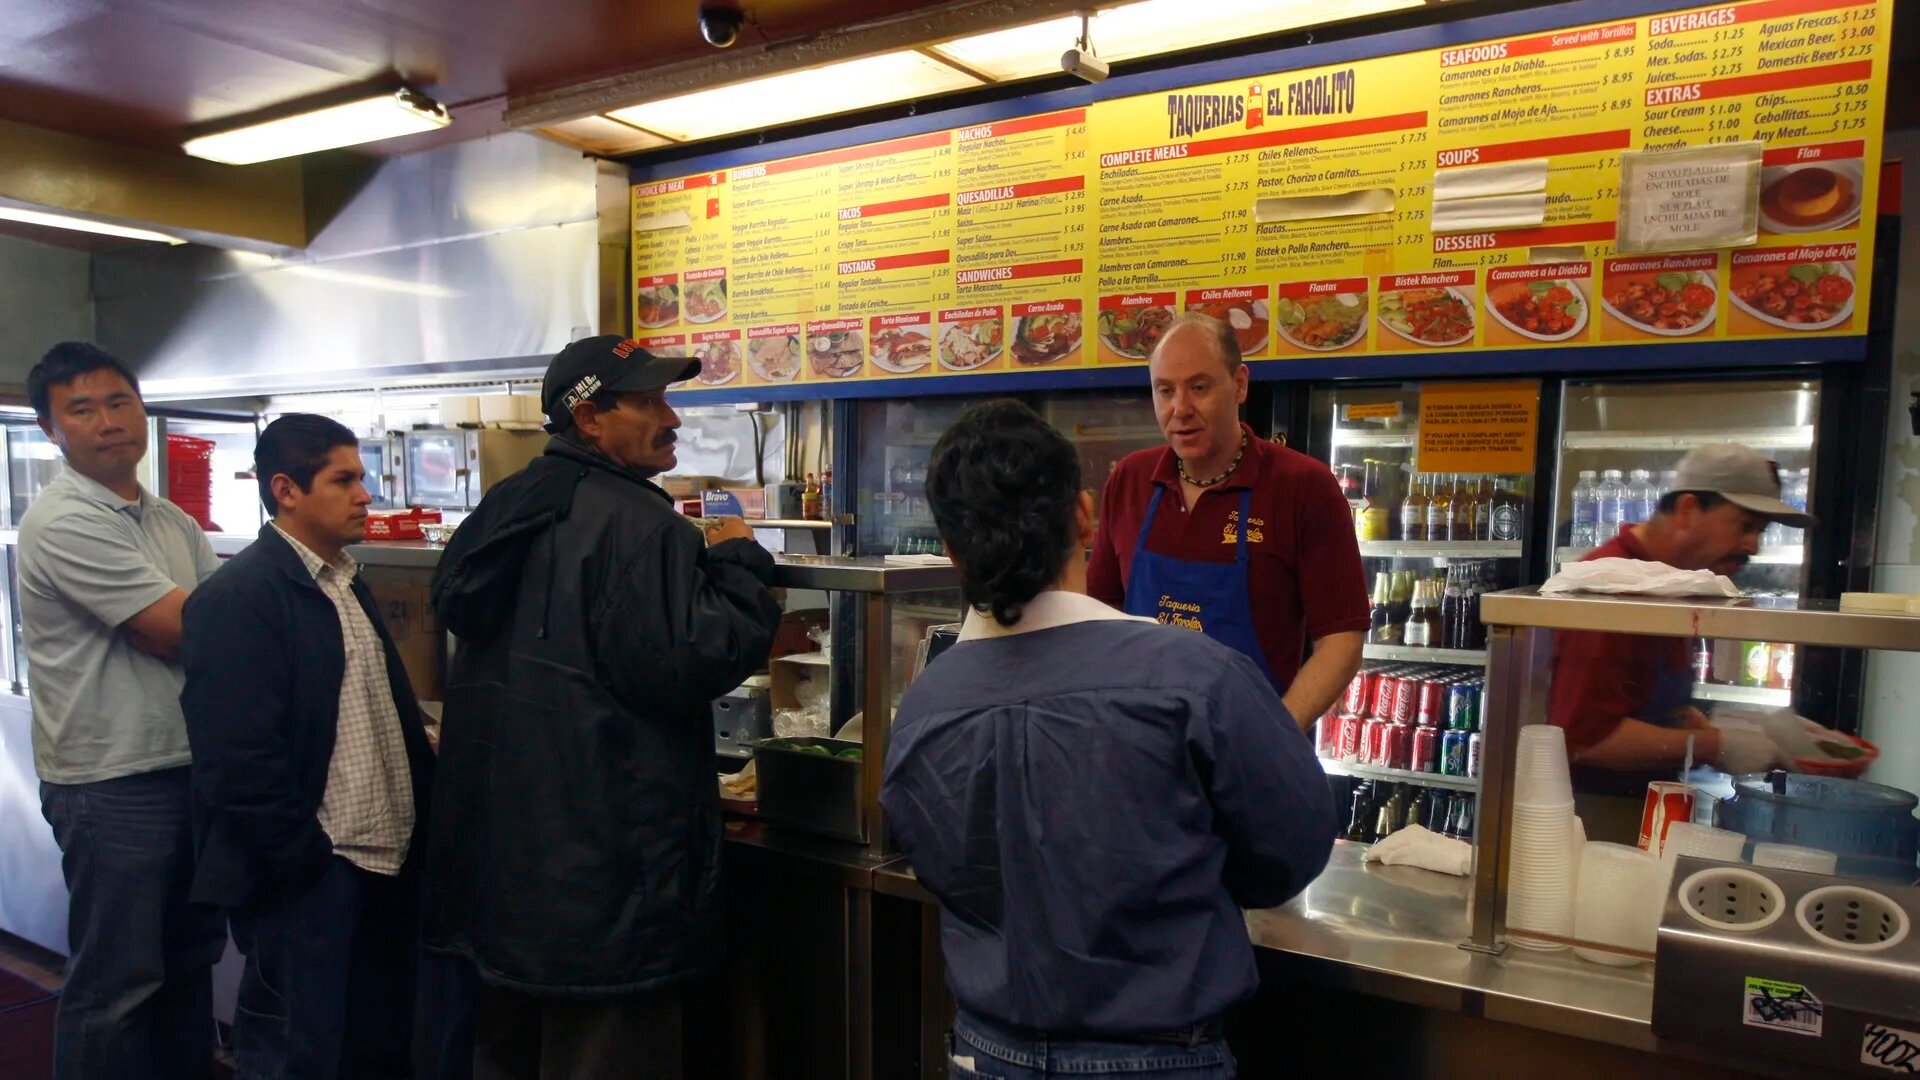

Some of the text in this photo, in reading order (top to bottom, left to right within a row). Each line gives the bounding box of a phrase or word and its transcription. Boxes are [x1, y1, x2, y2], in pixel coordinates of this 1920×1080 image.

[1651, 8, 1736, 34] BEVERAGES
[1759, 22, 1794, 36] Aguas
[1442, 25, 1633, 66] SEAFOODS Served with Tortillas
[1648, 38, 1673, 50] Soda
[1759, 38, 1804, 51] Mexican
[1647, 56, 1671, 67] Mex.
[1757, 54, 1808, 69] Domestic
[1811, 50, 1838, 61] Beer
[1440, 66, 1491, 82] Camarones
[1501, 63, 1511, 73] la
[1513, 59, 1545, 72] Diabla
[1646, 72, 1676, 84] Juices
[1439, 90, 1489, 105] Camarones
[1492, 83, 1541, 97] Rancheros
[1646, 84, 1700, 105] EXTRAS
[1755, 94, 1785, 108] Chips
[1168, 69, 1355, 139] TAQUERIAS EL FAROLITO
[1438, 112, 1489, 127] Camarones
[1491, 111, 1500, 121] al
[1502, 108, 1525, 122] Mojo
[1527, 107, 1538, 116] de
[1541, 103, 1557, 117] Ajo
[1645, 106, 1704, 121] Sour Cream
[1754, 109, 1809, 124] Cebollitas
[958, 126, 992, 141] NACHOS
[1643, 124, 1679, 137] Cheese
[1753, 126, 1807, 143] Any Meat
[958, 139, 1006, 152] Regular Nachos
[1643, 140, 1686, 152] Avocado
[1101, 144, 1187, 166] COMPLETE MEALS
[1258, 147, 1317, 161] Chiles Rellenos
[1438, 149, 1479, 166] SOUPS
[1797, 147, 1821, 159] Flan
[732, 165, 766, 180] BURRITOS
[958, 164, 999, 176] Super Nachos
[1101, 168, 1138, 179] Enchiladas
[1648, 169, 1682, 179] NUEVO
[1257, 178, 1285, 188] Pastor,
[1287, 173, 1316, 184] Chorizo
[1325, 170, 1360, 180] Carnitas
[1646, 175, 1729, 190] ENCHILADAS DE
[637, 180, 685, 196] CHOICE OF MEAT
[1671, 190, 1702, 198] MOLE
[958, 186, 1014, 205] QUESADILLAS
[1100, 194, 1143, 207] Carne Asada
[839, 207, 861, 220] TACOS
[1660, 202, 1681, 211] NEW
[1644, 209, 1727, 224] ENCHILADAS DE
[1100, 223, 1119, 233] Carne
[1121, 221, 1142, 230] Asada
[1144, 219, 1156, 228] con
[1158, 216, 1199, 227] Camarones
[1256, 224, 1285, 235] Flautas
[1669, 224, 1700, 233] MOLE
[1099, 237, 1132, 246] Alambres
[1256, 246, 1279, 256] Bistek
[1288, 243, 1308, 254] Pollo
[1310, 241, 1349, 251] Ranchero
[1435, 233, 1496, 251] DESSERTS
[957, 252, 988, 263] Quesadilla
[989, 250, 1004, 260] para
[1005, 249, 1016, 257] Dos
[1733, 246, 1856, 264] Camarones al Mojo de Ajo
[839, 260, 876, 274] TOSTADAS
[1098, 263, 1132, 273] Alambres
[1133, 260, 1146, 269] con
[1147, 258, 1188, 268] Camarones
[1433, 258, 1453, 268] Flan
[1610, 258, 1712, 272] Camarones Rancheros
[957, 267, 1012, 283] SANDWICHES
[1492, 270, 1539, 279] Camarones
[1548, 267, 1556, 276] la
[1557, 265, 1587, 275] Diabla
[1099, 276, 1116, 286] Pollo
[1123, 276, 1130, 284] la
[1131, 273, 1159, 284] Parrilla
[1395, 274, 1459, 286] Bistek Ranchero
[956, 283, 1002, 293] Torta Mexicana
[1202, 289, 1252, 299] Chiles Rellenos
[1309, 282, 1336, 292] Flautas
[1028, 303, 1064, 312] Carne Asada
[1122, 296, 1152, 305] Alambres
[881, 315, 919, 325] Torta Mexicana
[706, 492, 729, 502] Bravo
[1228, 511, 1264, 526] Taeria
[1158, 595, 1201, 612] Taqueria
[1157, 612, 1168, 624] El
